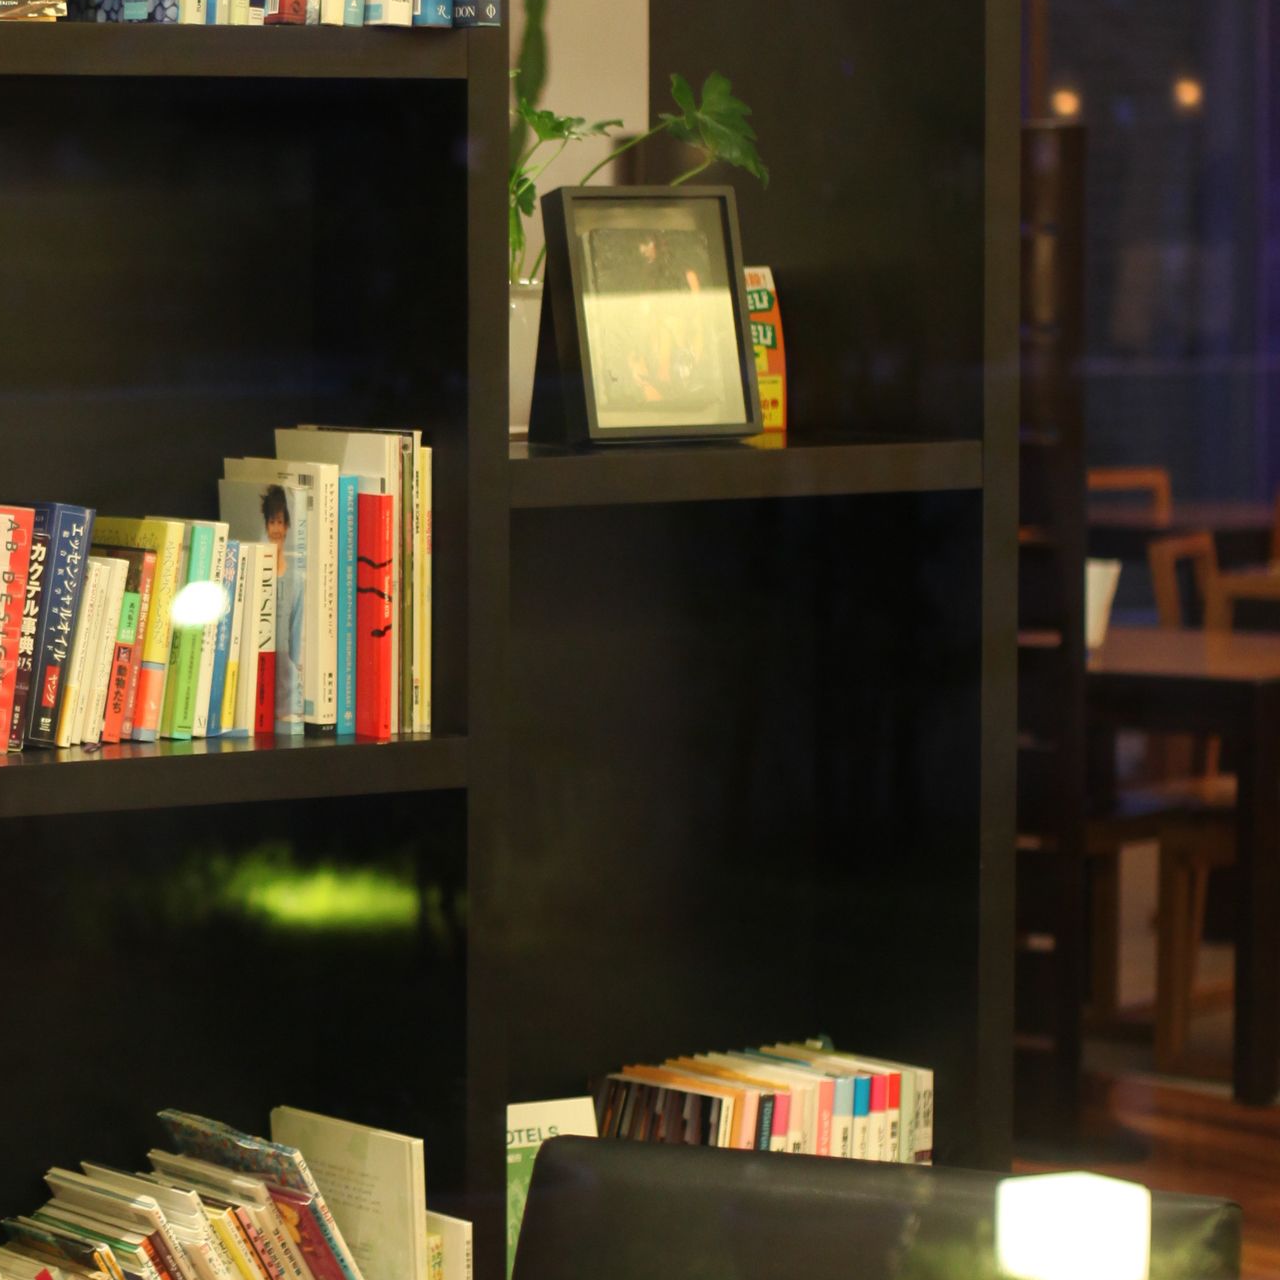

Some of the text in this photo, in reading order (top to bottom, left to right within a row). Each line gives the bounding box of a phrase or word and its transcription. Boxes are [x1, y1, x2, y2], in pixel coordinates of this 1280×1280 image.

[297, 518, 308, 570] Natural
[17, 542, 47, 657] カクテル事典
[52, 523, 84, 664] エッセンシャルオイル
[45, 672, 58, 705] ヤング
[506, 1125, 560, 1146] OTELS
